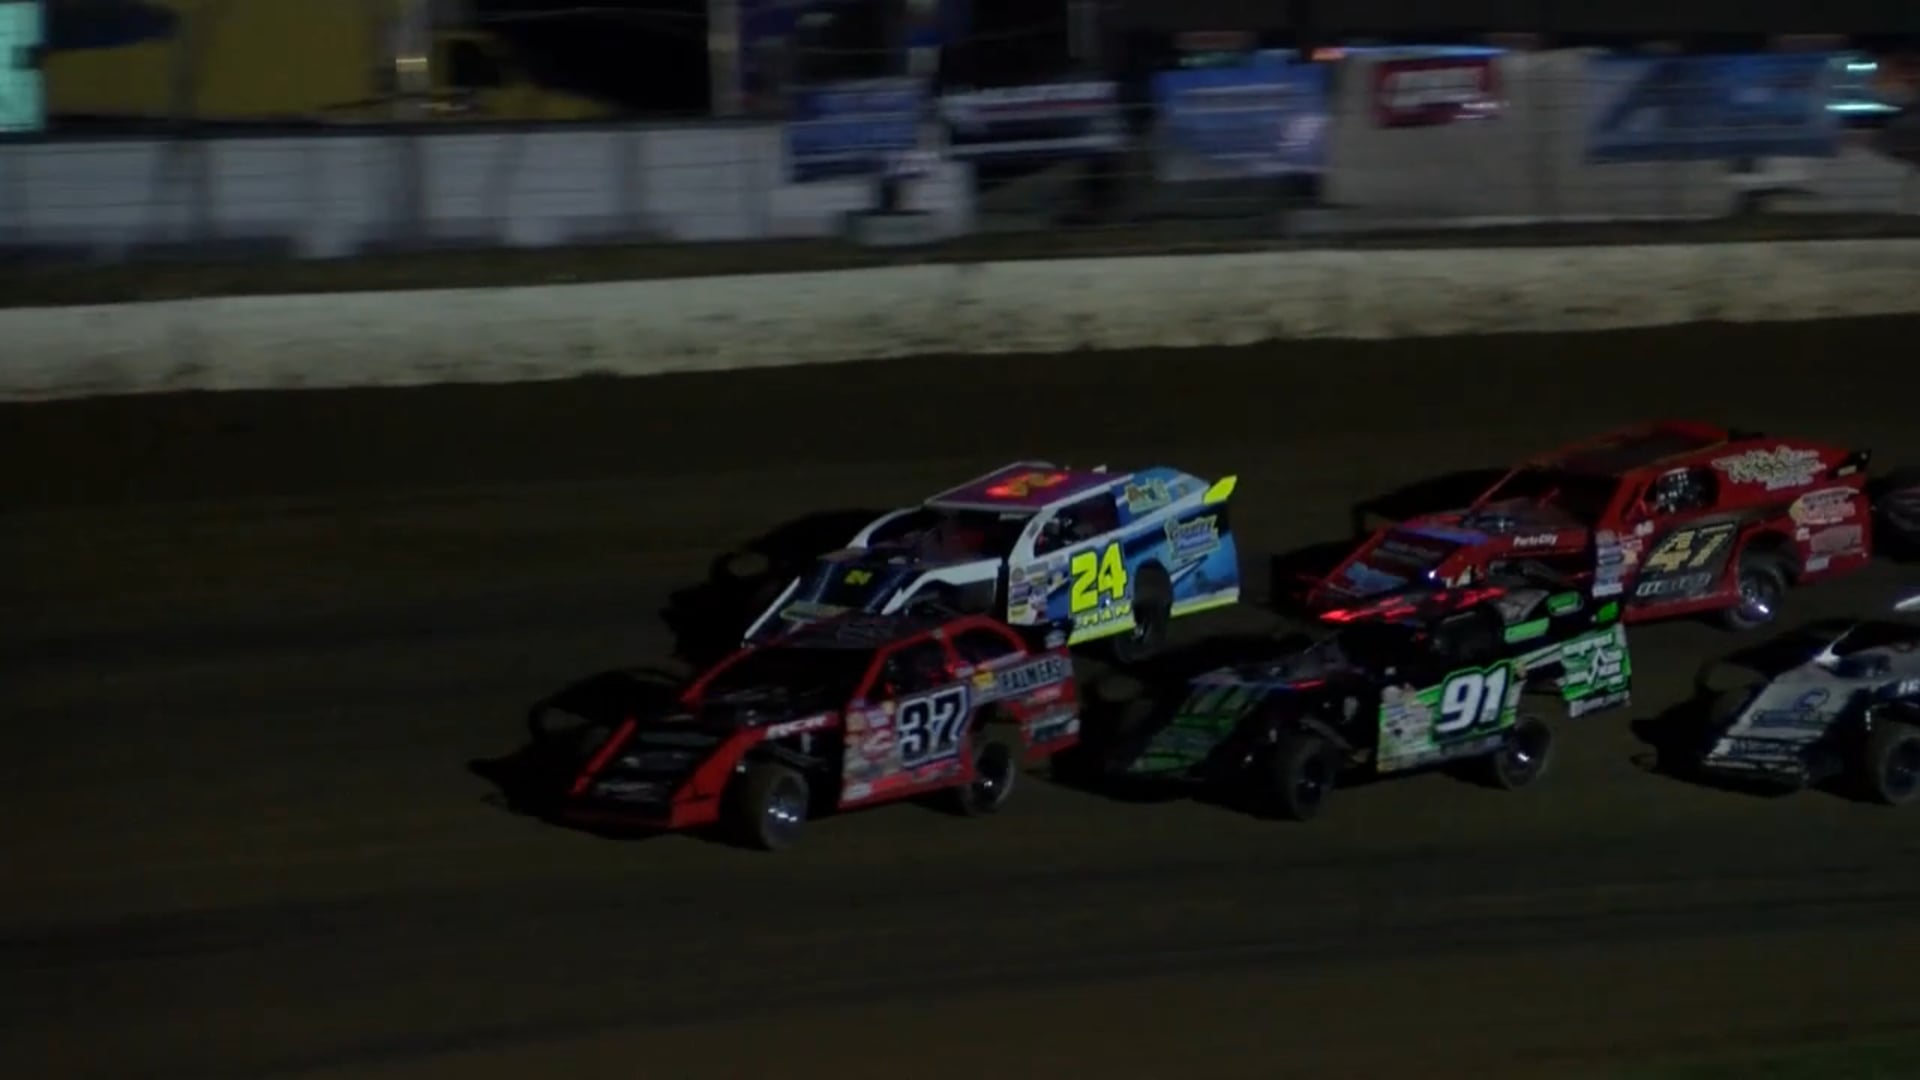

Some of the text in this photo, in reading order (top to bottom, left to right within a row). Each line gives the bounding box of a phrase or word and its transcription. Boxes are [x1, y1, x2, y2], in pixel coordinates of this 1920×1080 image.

[1069, 542, 1127, 614] 24
[1643, 523, 1735, 573] 47
[1001, 658, 1066, 694] PALMERS
[1436, 665, 1508, 733] 91
[900, 688, 966, 766] 37
